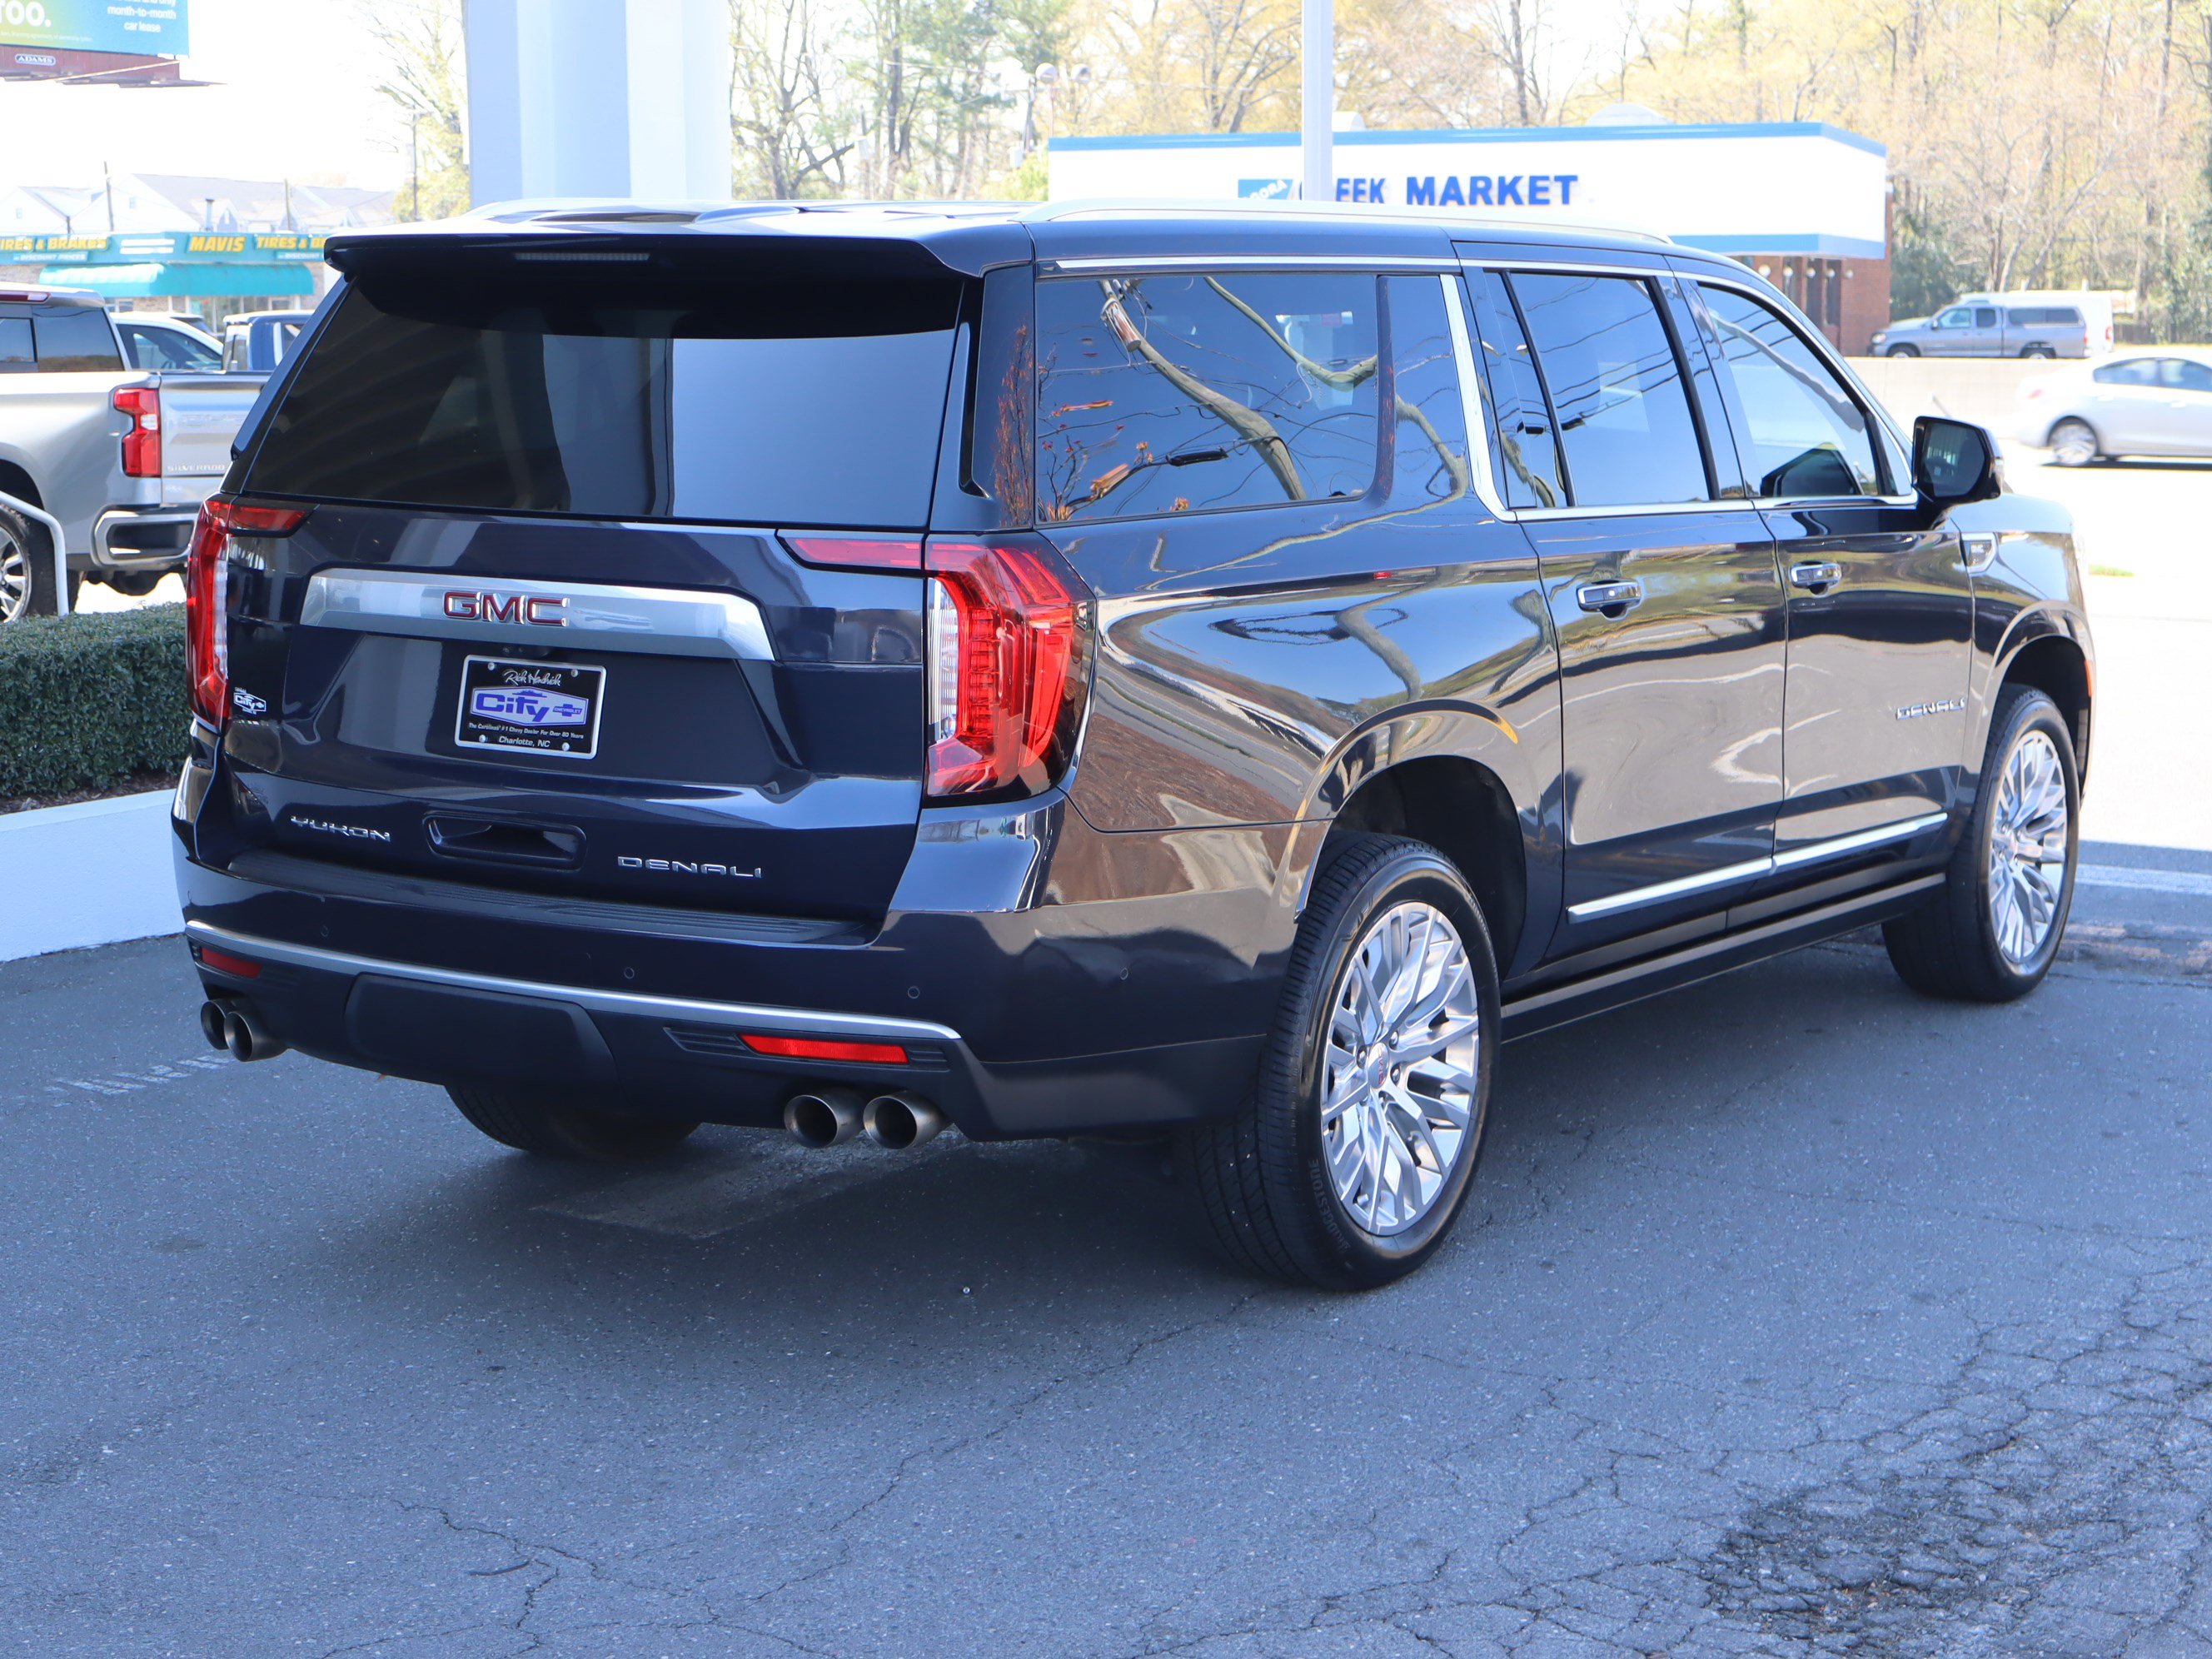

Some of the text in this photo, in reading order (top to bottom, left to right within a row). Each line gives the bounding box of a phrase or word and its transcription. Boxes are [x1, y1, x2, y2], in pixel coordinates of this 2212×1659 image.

[107, 6, 177, 19] month-to-month
[123, 21, 162, 32] car lease
[1406, 176, 1578, 207] MARKET
[0, 237, 107, 251] IRES & BRAKES
[188, 236, 246, 252] MAVIS
[257, 237, 297, 249] TIRES
[300, 238, 308, 249] &
[444, 592, 570, 626] GMC
[503, 670, 562, 687] Rick Hendrick
[476, 692, 551, 722] City
[1896, 698, 1966, 720] DENALI
[498, 735, 551, 748] Charlotte, NC
[291, 816, 391, 842] YUKON
[617, 856, 762, 879] DENALI
